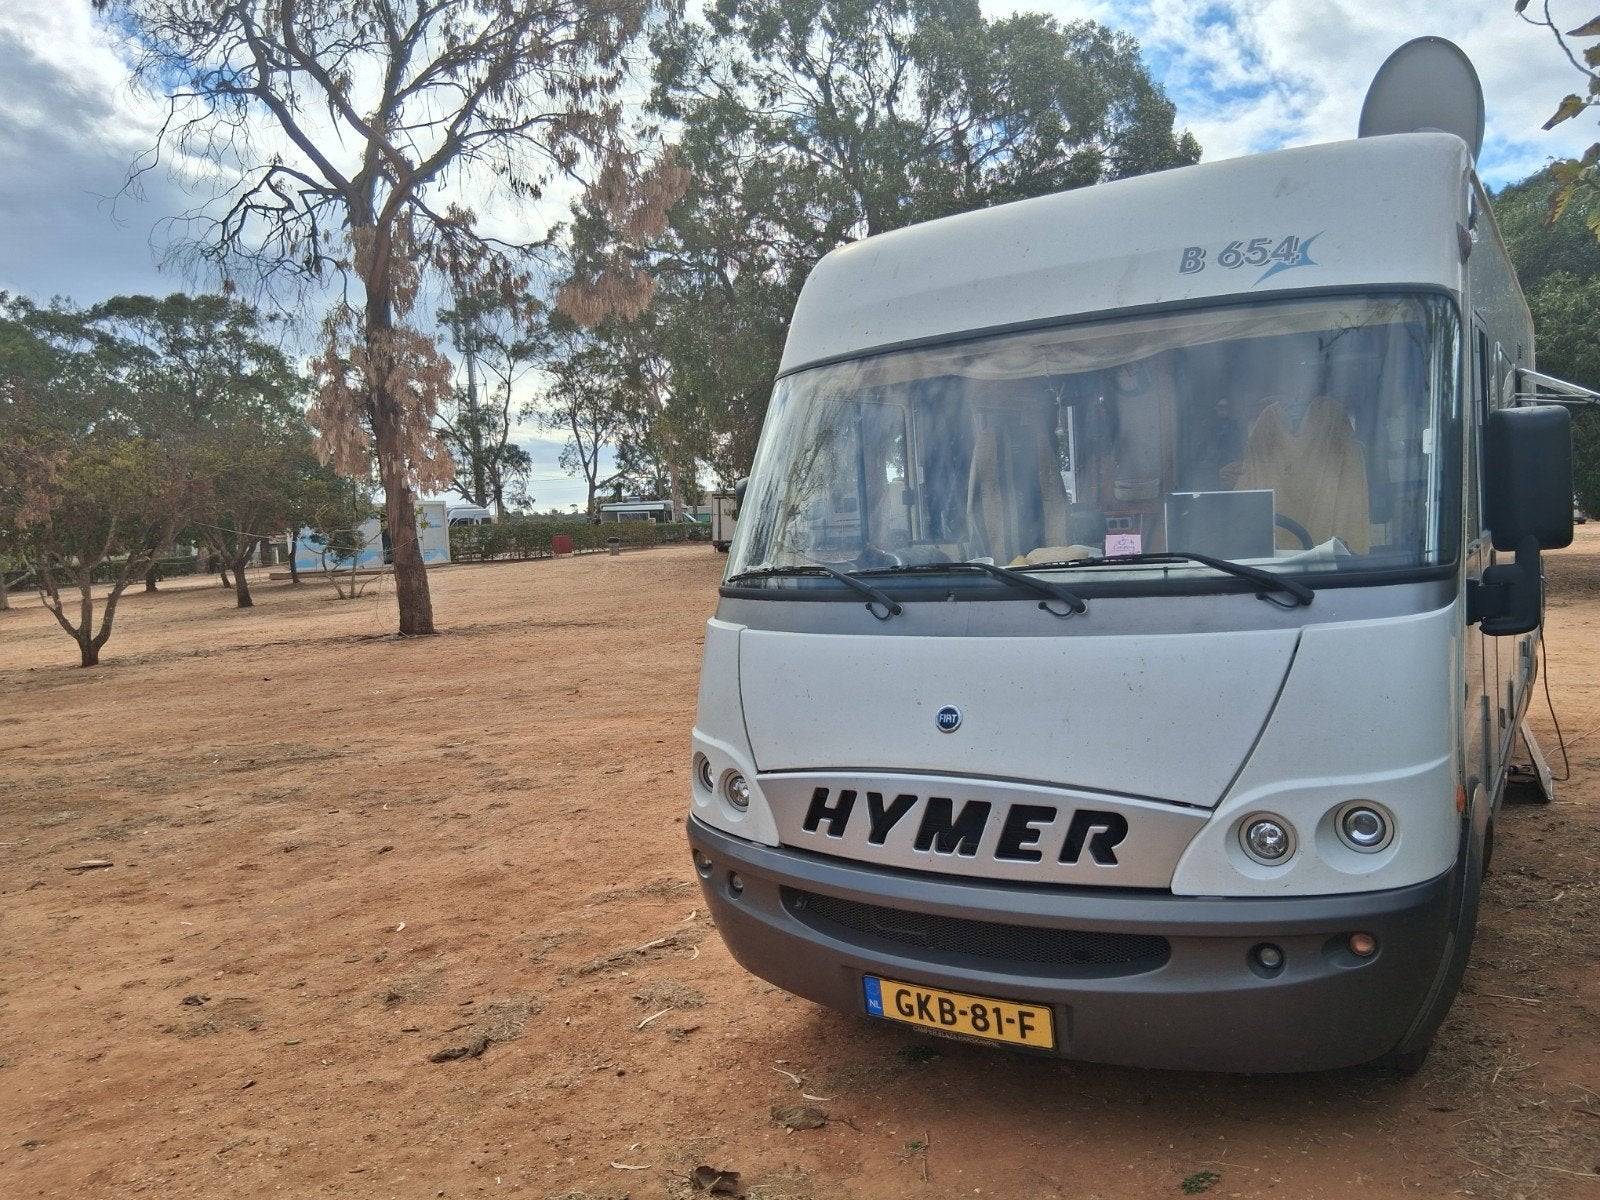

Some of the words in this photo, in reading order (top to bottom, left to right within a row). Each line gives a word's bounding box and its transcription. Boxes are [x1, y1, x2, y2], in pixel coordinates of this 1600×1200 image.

[1178, 246, 1207, 275] B
[1217, 235, 1300, 270] 654
[939, 713, 958, 724] FIAT
[802, 787, 1129, 867] HYMER
[869, 999, 882, 1009] NL
[895, 988, 1035, 1039] GKB-81-F
